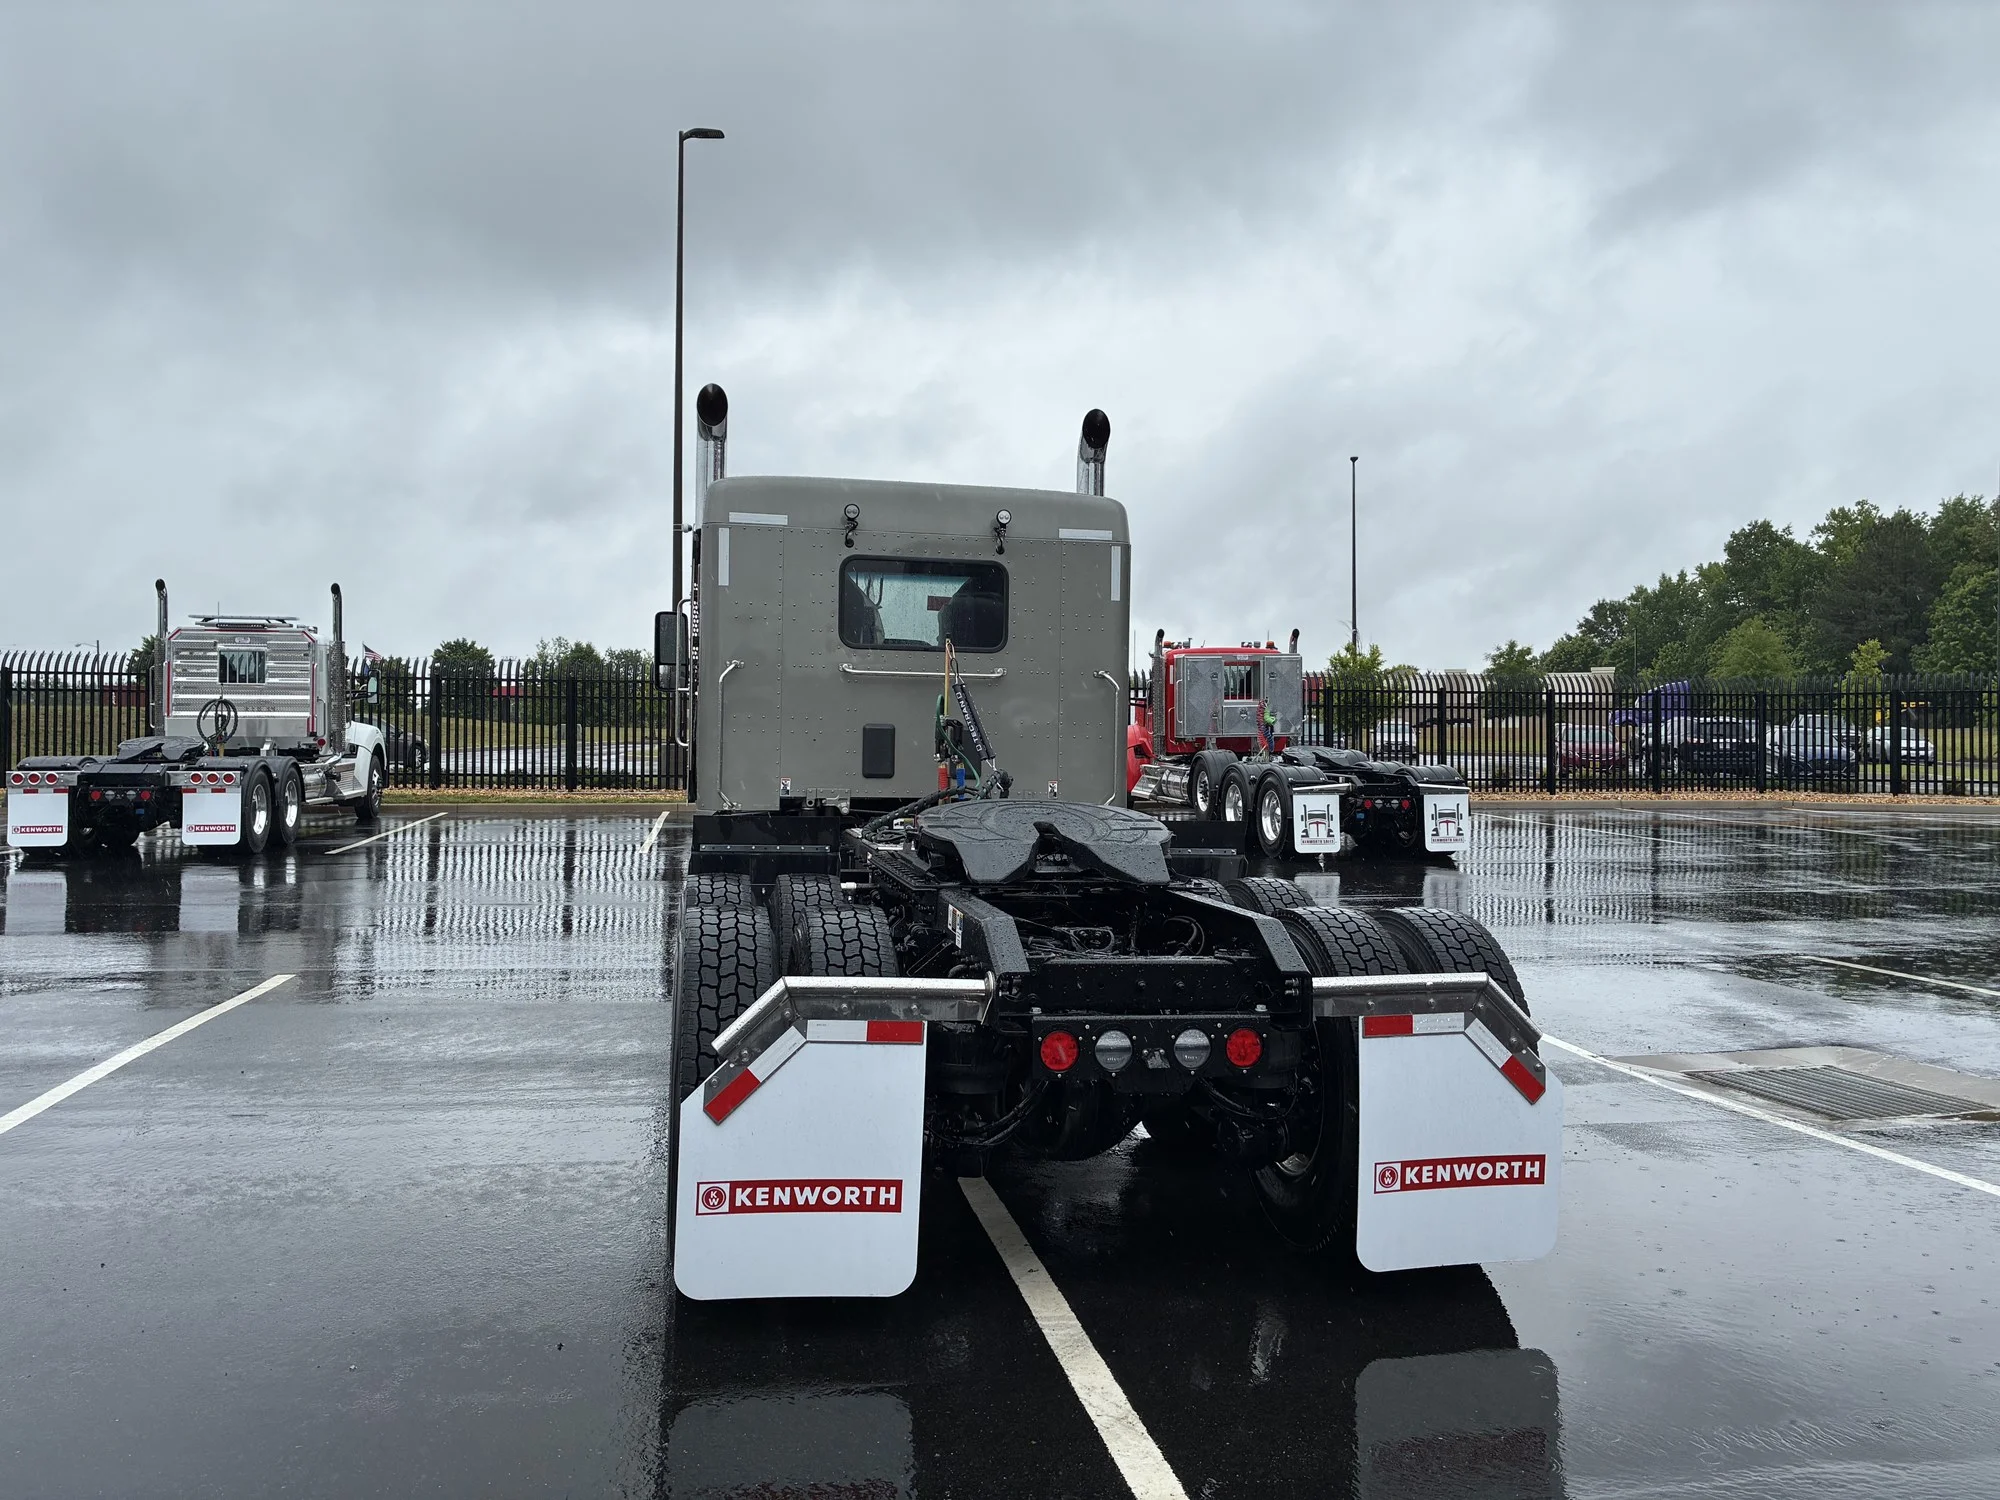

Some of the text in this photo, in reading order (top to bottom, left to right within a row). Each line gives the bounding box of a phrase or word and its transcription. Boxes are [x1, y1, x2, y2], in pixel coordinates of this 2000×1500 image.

[960, 700, 979, 743] TECTRAN
[1405, 1161, 1540, 1185] KENWORTH
[735, 1186, 896, 1207] KENWORTH
